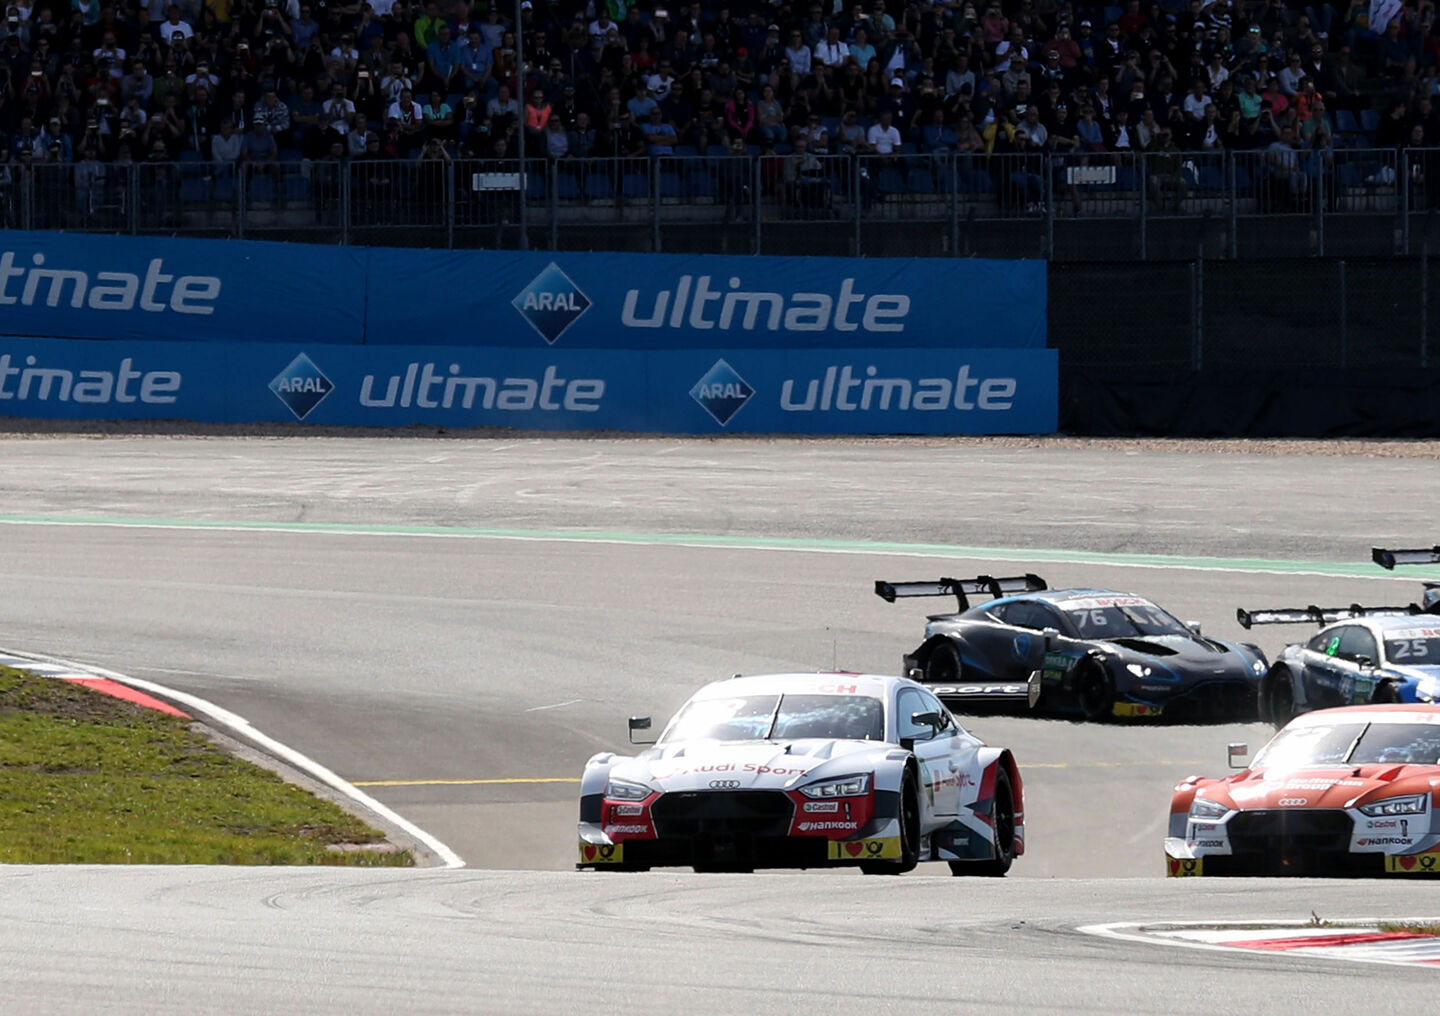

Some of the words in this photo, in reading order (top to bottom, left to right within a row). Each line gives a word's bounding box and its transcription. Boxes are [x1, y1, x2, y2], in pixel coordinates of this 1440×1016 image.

[523, 290, 581, 312] ARAL
[621, 274, 912, 332] ultimate
[277, 377, 326, 393] ARAL
[358, 362, 606, 412] ultimate
[699, 384, 747, 400] ARAL
[780, 364, 1017, 411] ultimate
[1072, 609, 1108, 629] 76
[1393, 639, 1429, 659] 25
[742, 763, 808, 777] Sport
